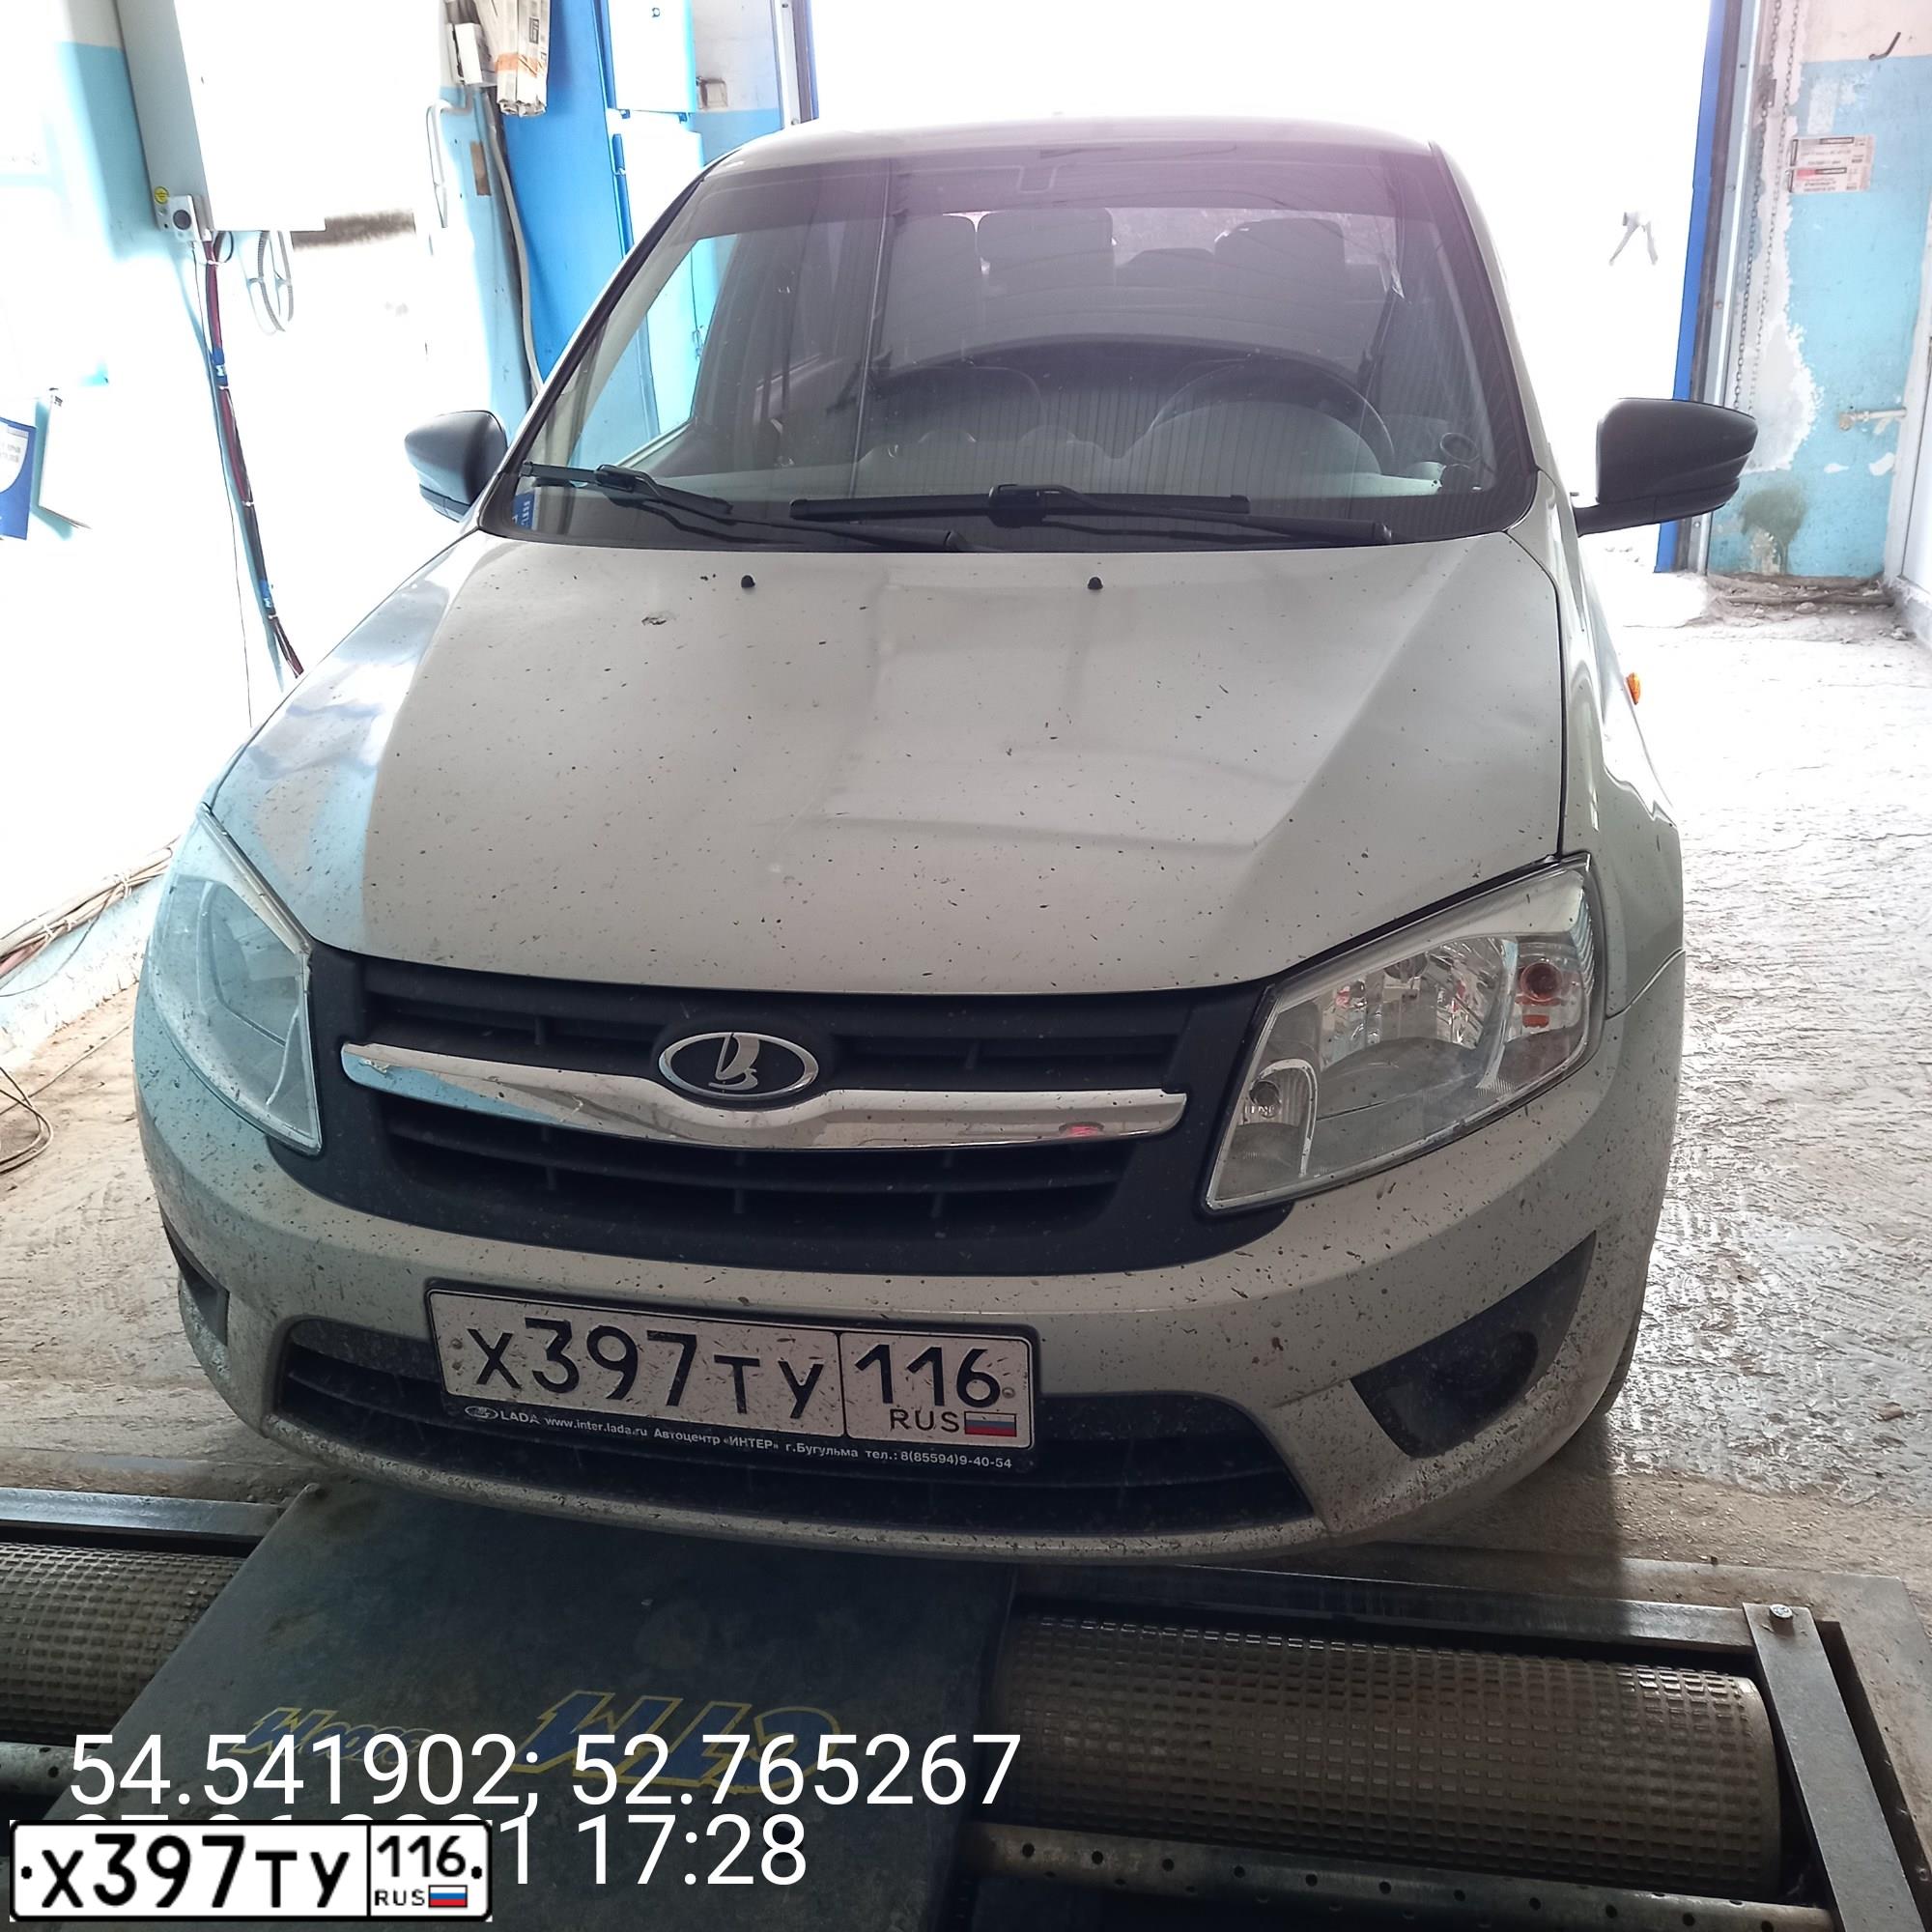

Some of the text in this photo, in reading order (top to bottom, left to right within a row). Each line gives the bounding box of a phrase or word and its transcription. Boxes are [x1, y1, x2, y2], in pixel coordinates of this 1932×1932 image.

[467, 1316, 1002, 1419] Х397ТУ 116
[499, 1409, 541, 1426] LADA
[653, 1427, 721, 1446] Автоцентр
[785, 1442, 859, 1459] г.Бугульма
[865, 1449, 898, 1461] тел.:
[899, 1450, 1013, 1468] 8(85594)9-40-54
[889, 1407, 960, 1433] RUS
